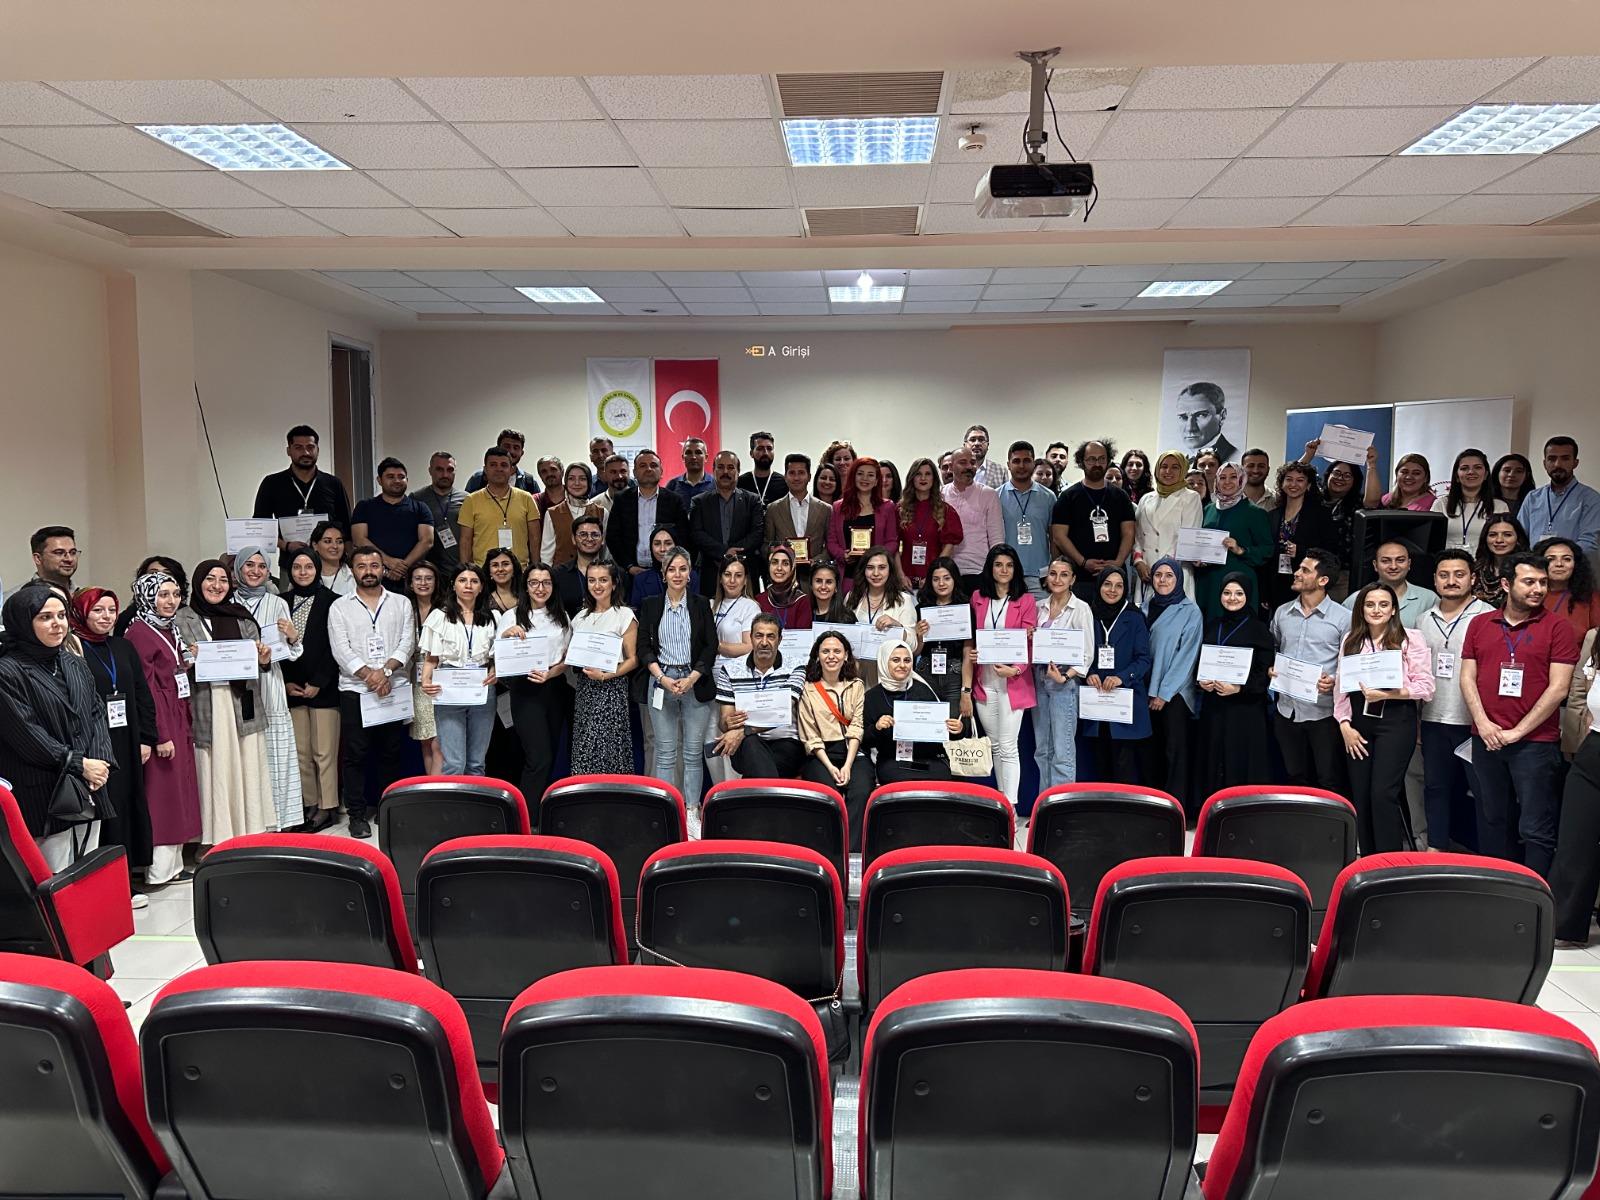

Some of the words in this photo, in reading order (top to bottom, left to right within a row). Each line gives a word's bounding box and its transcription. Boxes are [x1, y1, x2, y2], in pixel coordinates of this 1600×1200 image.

[768, 346, 776, 356] A
[782, 346, 810, 358] Girişi
[950, 748, 984, 758] TOKYO
